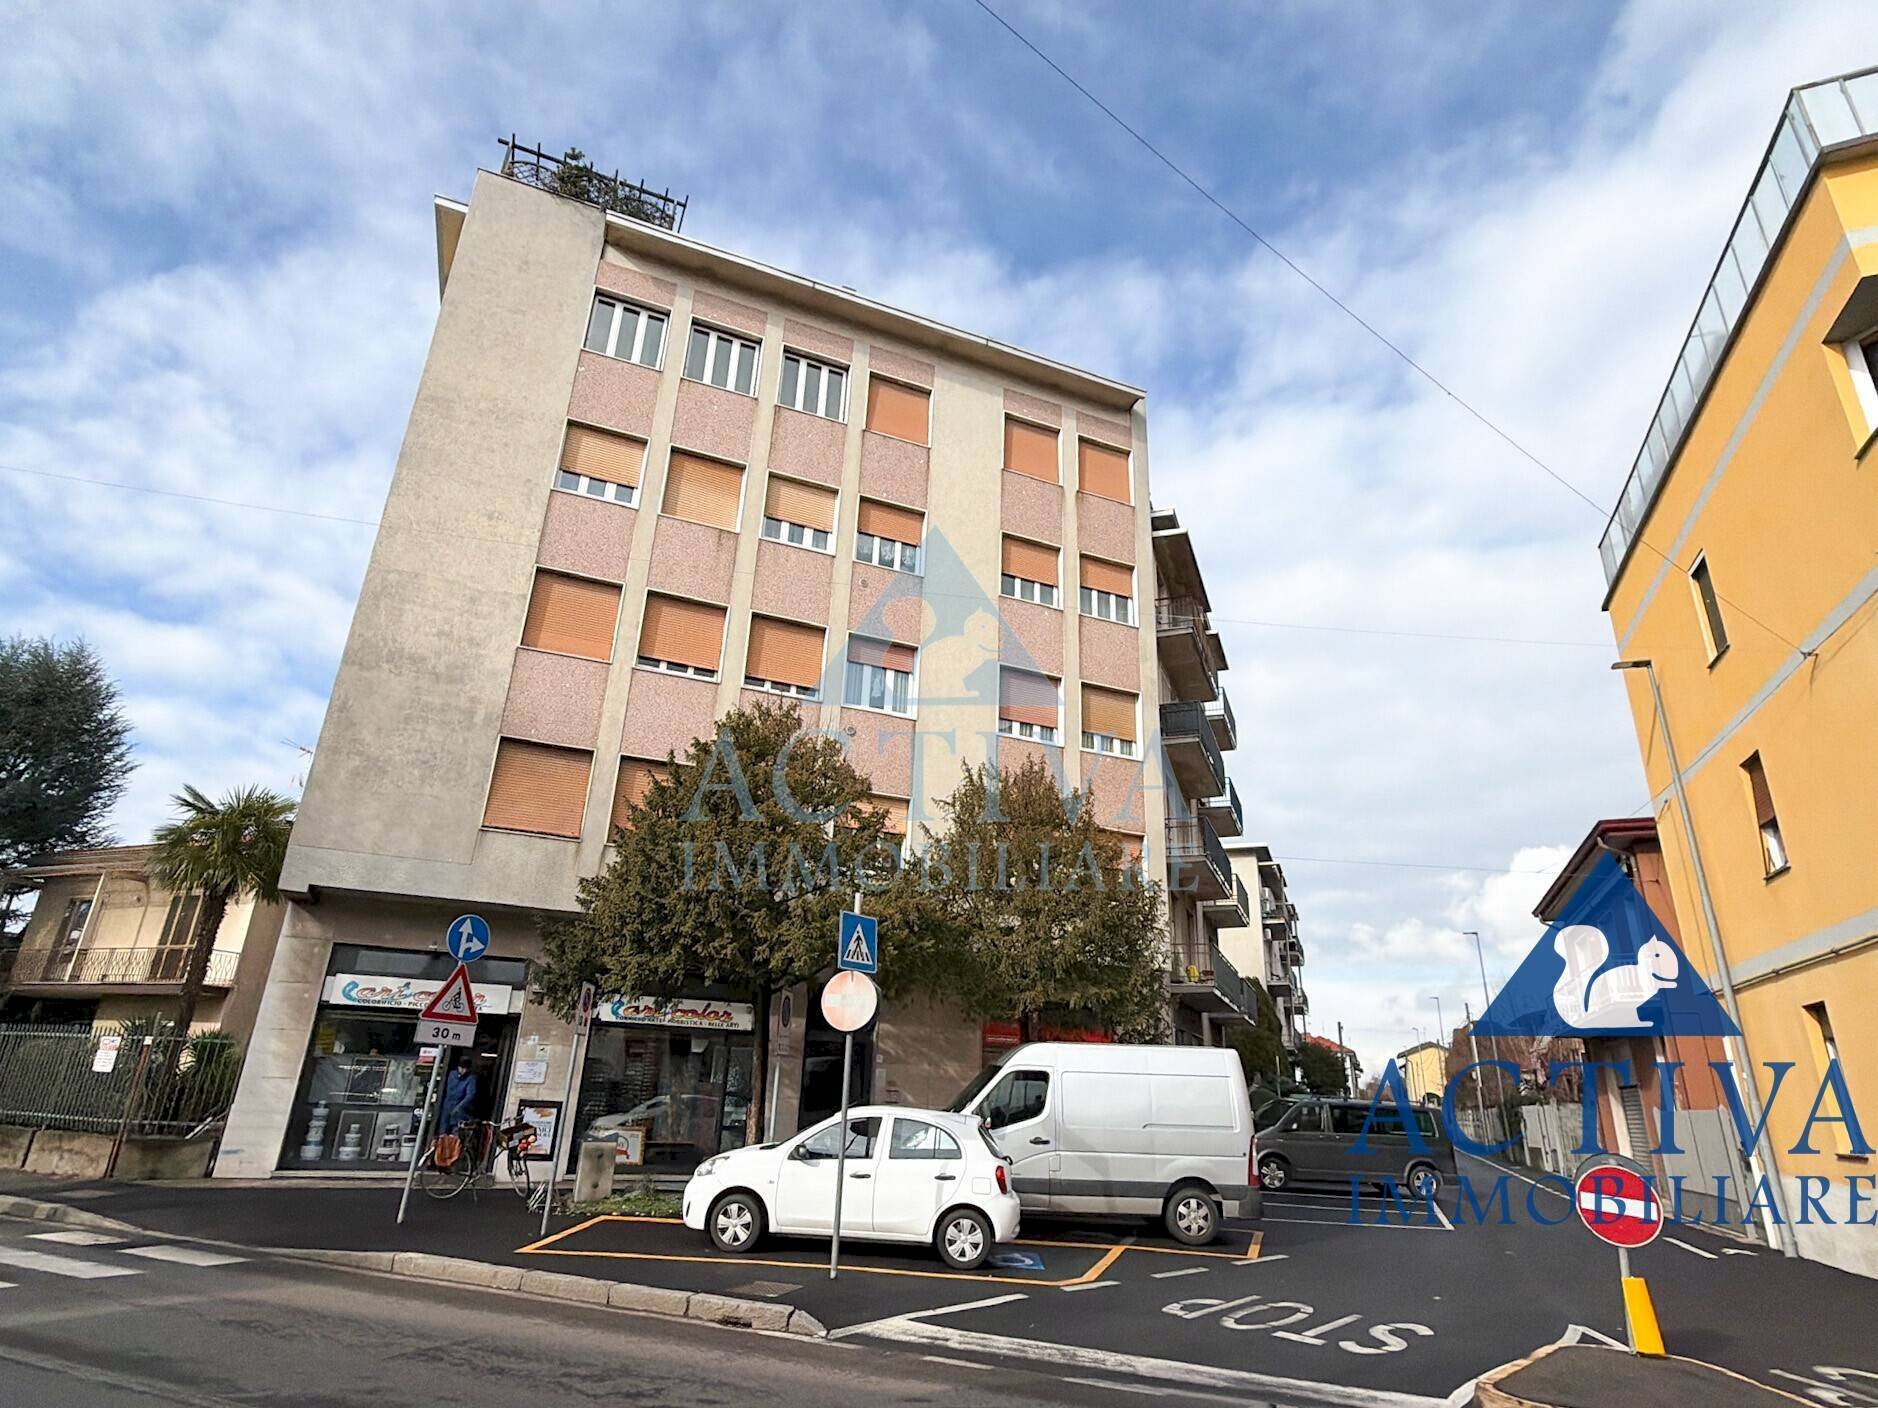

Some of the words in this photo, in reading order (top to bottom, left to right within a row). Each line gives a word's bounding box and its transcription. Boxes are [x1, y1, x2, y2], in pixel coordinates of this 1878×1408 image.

[431, 1026, 450, 1040] 30
[451, 1032, 461, 1041] m
[1161, 1294, 1435, 1355] STOP
